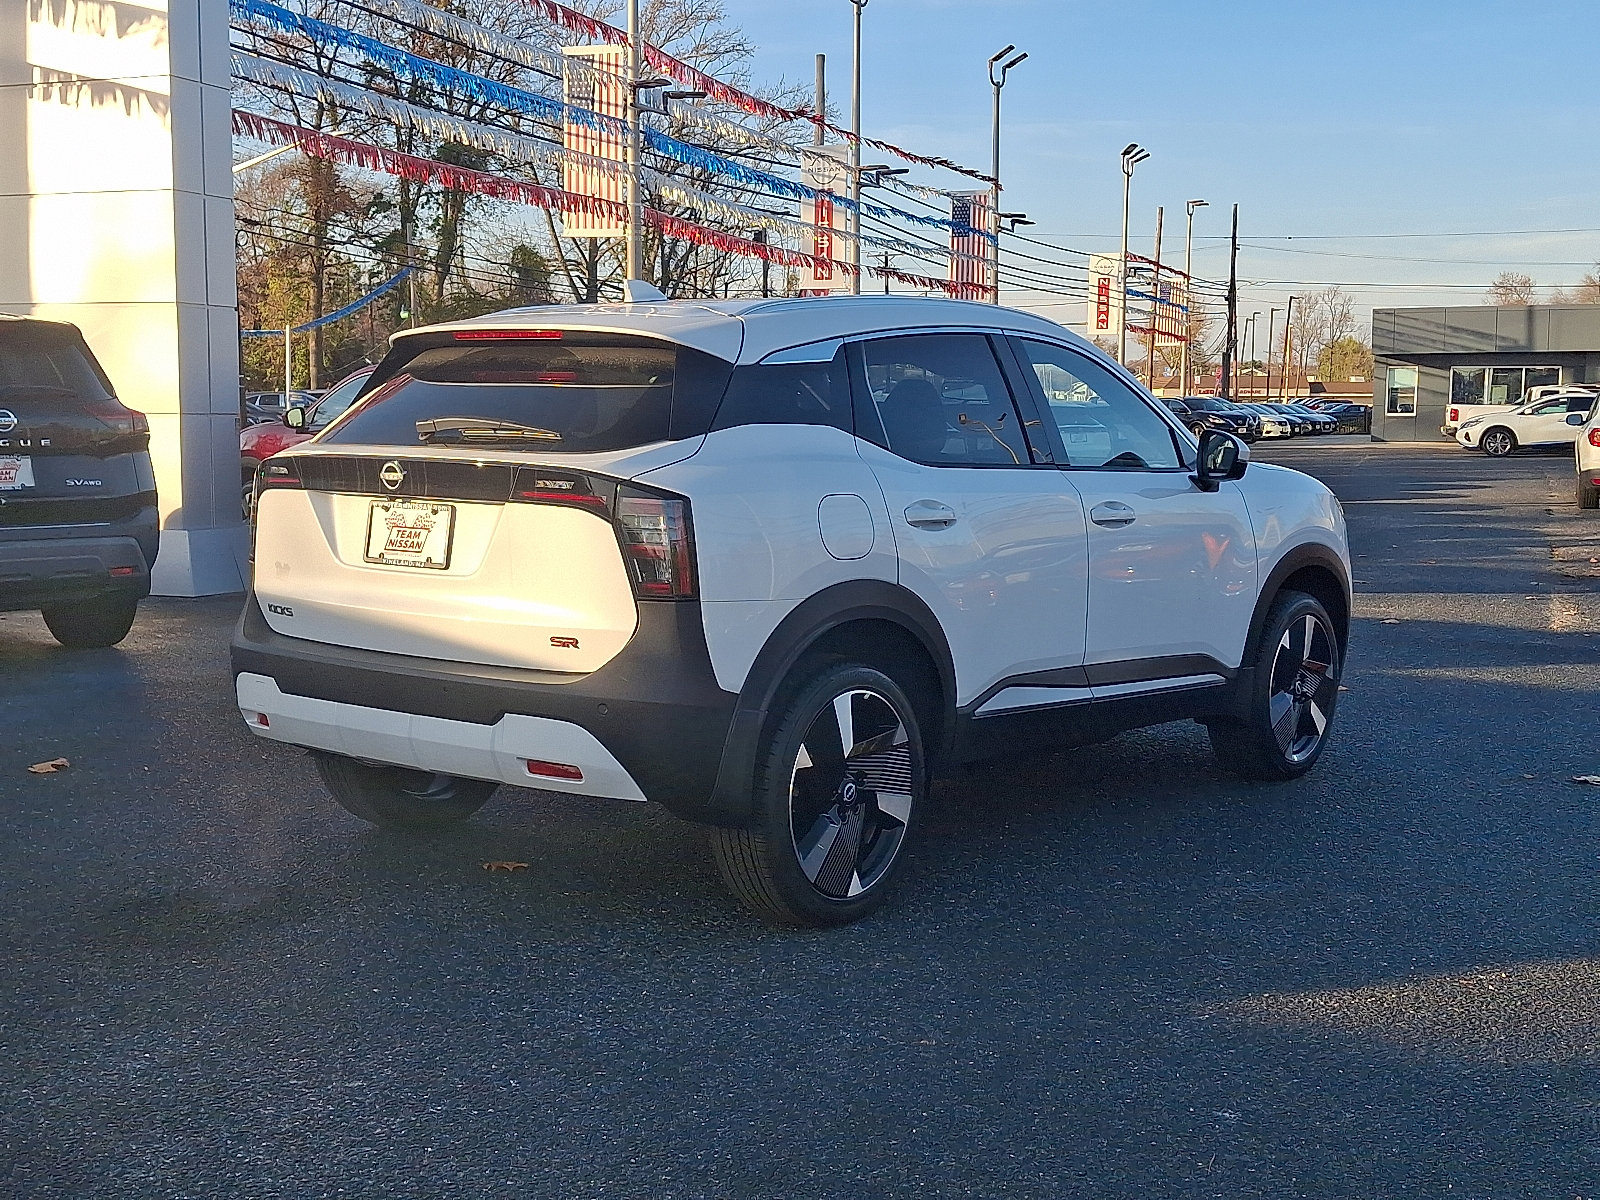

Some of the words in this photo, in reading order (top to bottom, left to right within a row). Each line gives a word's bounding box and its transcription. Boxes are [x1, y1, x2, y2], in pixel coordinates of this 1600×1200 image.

[807, 166, 842, 174] NISSAN
[1097, 278, 1110, 329] NISSAN
[395, 529, 422, 540] TEAM
[387, 539, 423, 550] NISSAN
[267, 603, 294, 617] KICKS
[550, 636, 580, 649] SR
